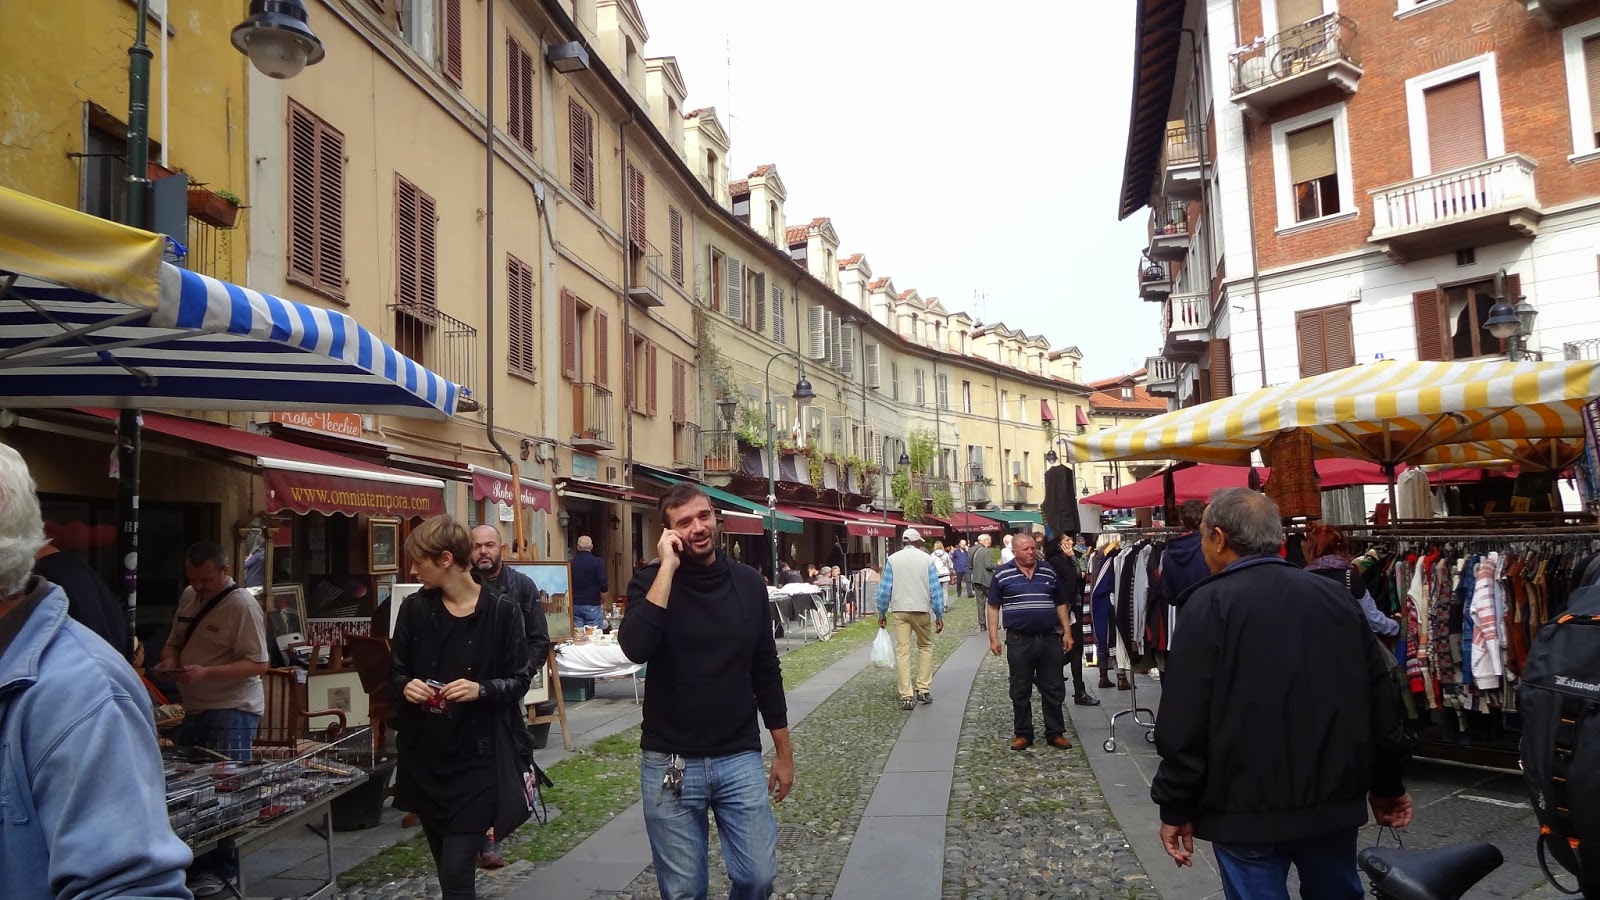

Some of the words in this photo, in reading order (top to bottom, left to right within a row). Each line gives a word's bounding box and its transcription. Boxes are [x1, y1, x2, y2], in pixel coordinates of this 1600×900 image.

[281, 412, 315, 427] Robe
[315, 412, 360, 436] Vecchie
[290, 487, 430, 512] www.omniatempora.com
[493, 480, 513, 500] Robe
